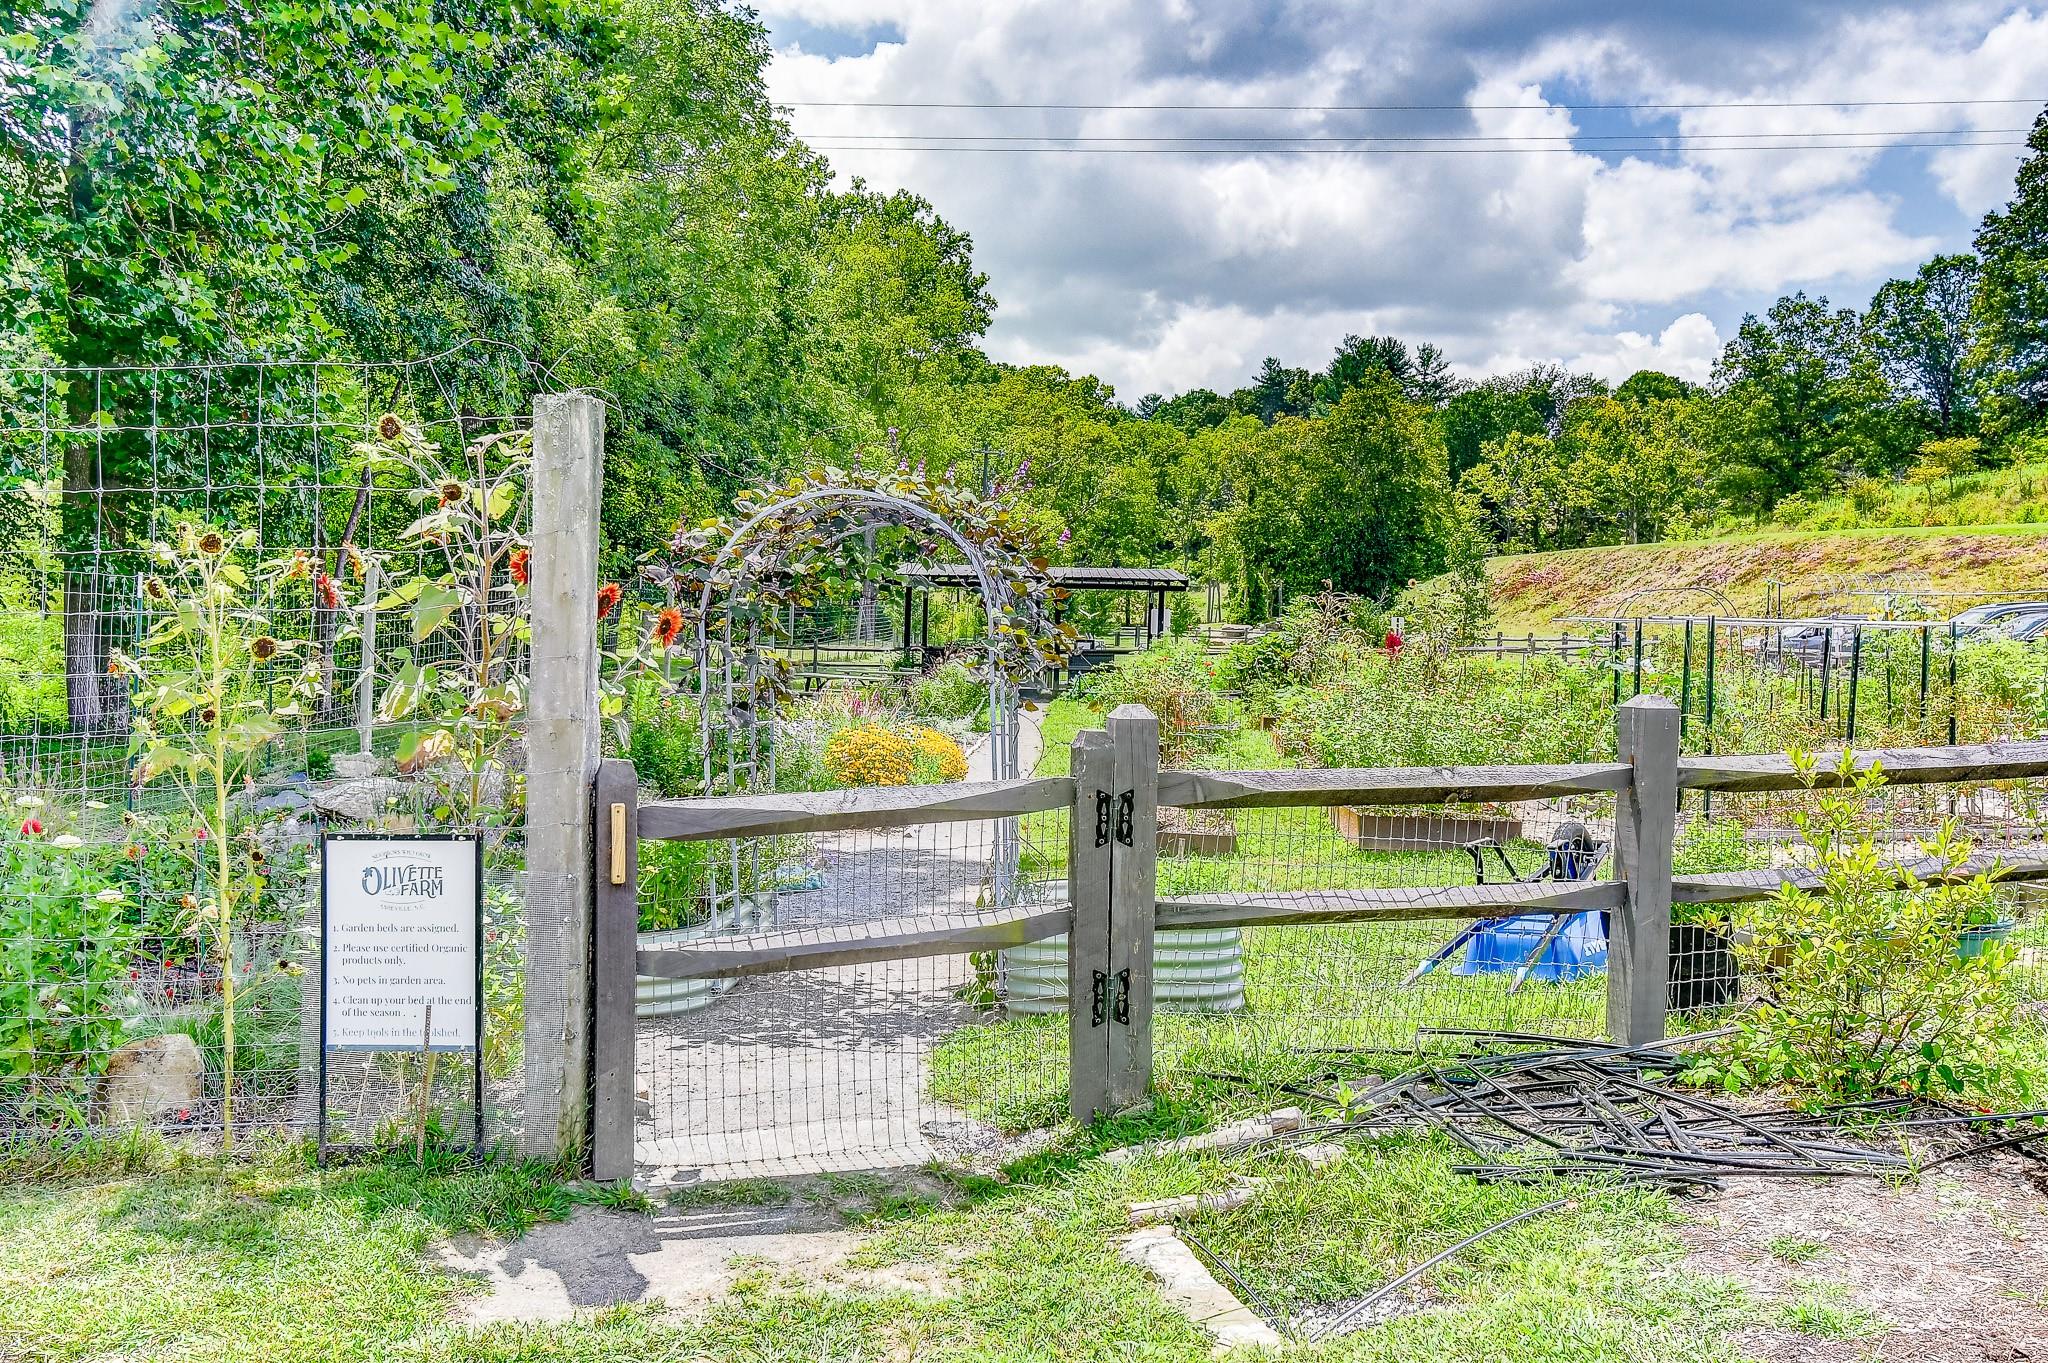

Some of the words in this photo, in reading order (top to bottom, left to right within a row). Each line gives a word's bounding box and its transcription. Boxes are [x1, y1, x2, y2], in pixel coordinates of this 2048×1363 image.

[361, 864, 443, 896] OLIVETTE
[400, 879, 443, 899] FARM
[341, 923, 375, 932] Garden
[377, 923, 398, 932] beds
[417, 923, 459, 935] assigned.
[342, 943, 371, 952] Please
[390, 943, 429, 952] certified
[431, 943, 468, 954] Organic
[342, 955, 382, 966] products
[384, 955, 406, 966] only.
[333, 977, 340, 986] 3.
[342, 975, 355, 984] No
[357, 976, 377, 986] pets
[378, 975, 388, 984] in
[389, 975, 422, 987] garden
[423, 977, 446, 985] area.
[332, 997, 340, 1005] 4.
[342, 995, 369, 1004] Clean
[371, 998, 383, 1006] up
[384, 998, 406, 1006] your
[407, 995, 425, 1004] bed
[426, 996, 435, 1004] at
[438, 995, 453, 1004] the
[454, 995, 472, 1004] end
[341, 1007, 352, 1016] of
[353, 1007, 368, 1016] the
[342, 1028, 365, 1038] Keep
[367, 1028, 389, 1037] tools
[391, 1027, 400, 1036] in
[402, 1028, 417, 1036] the
